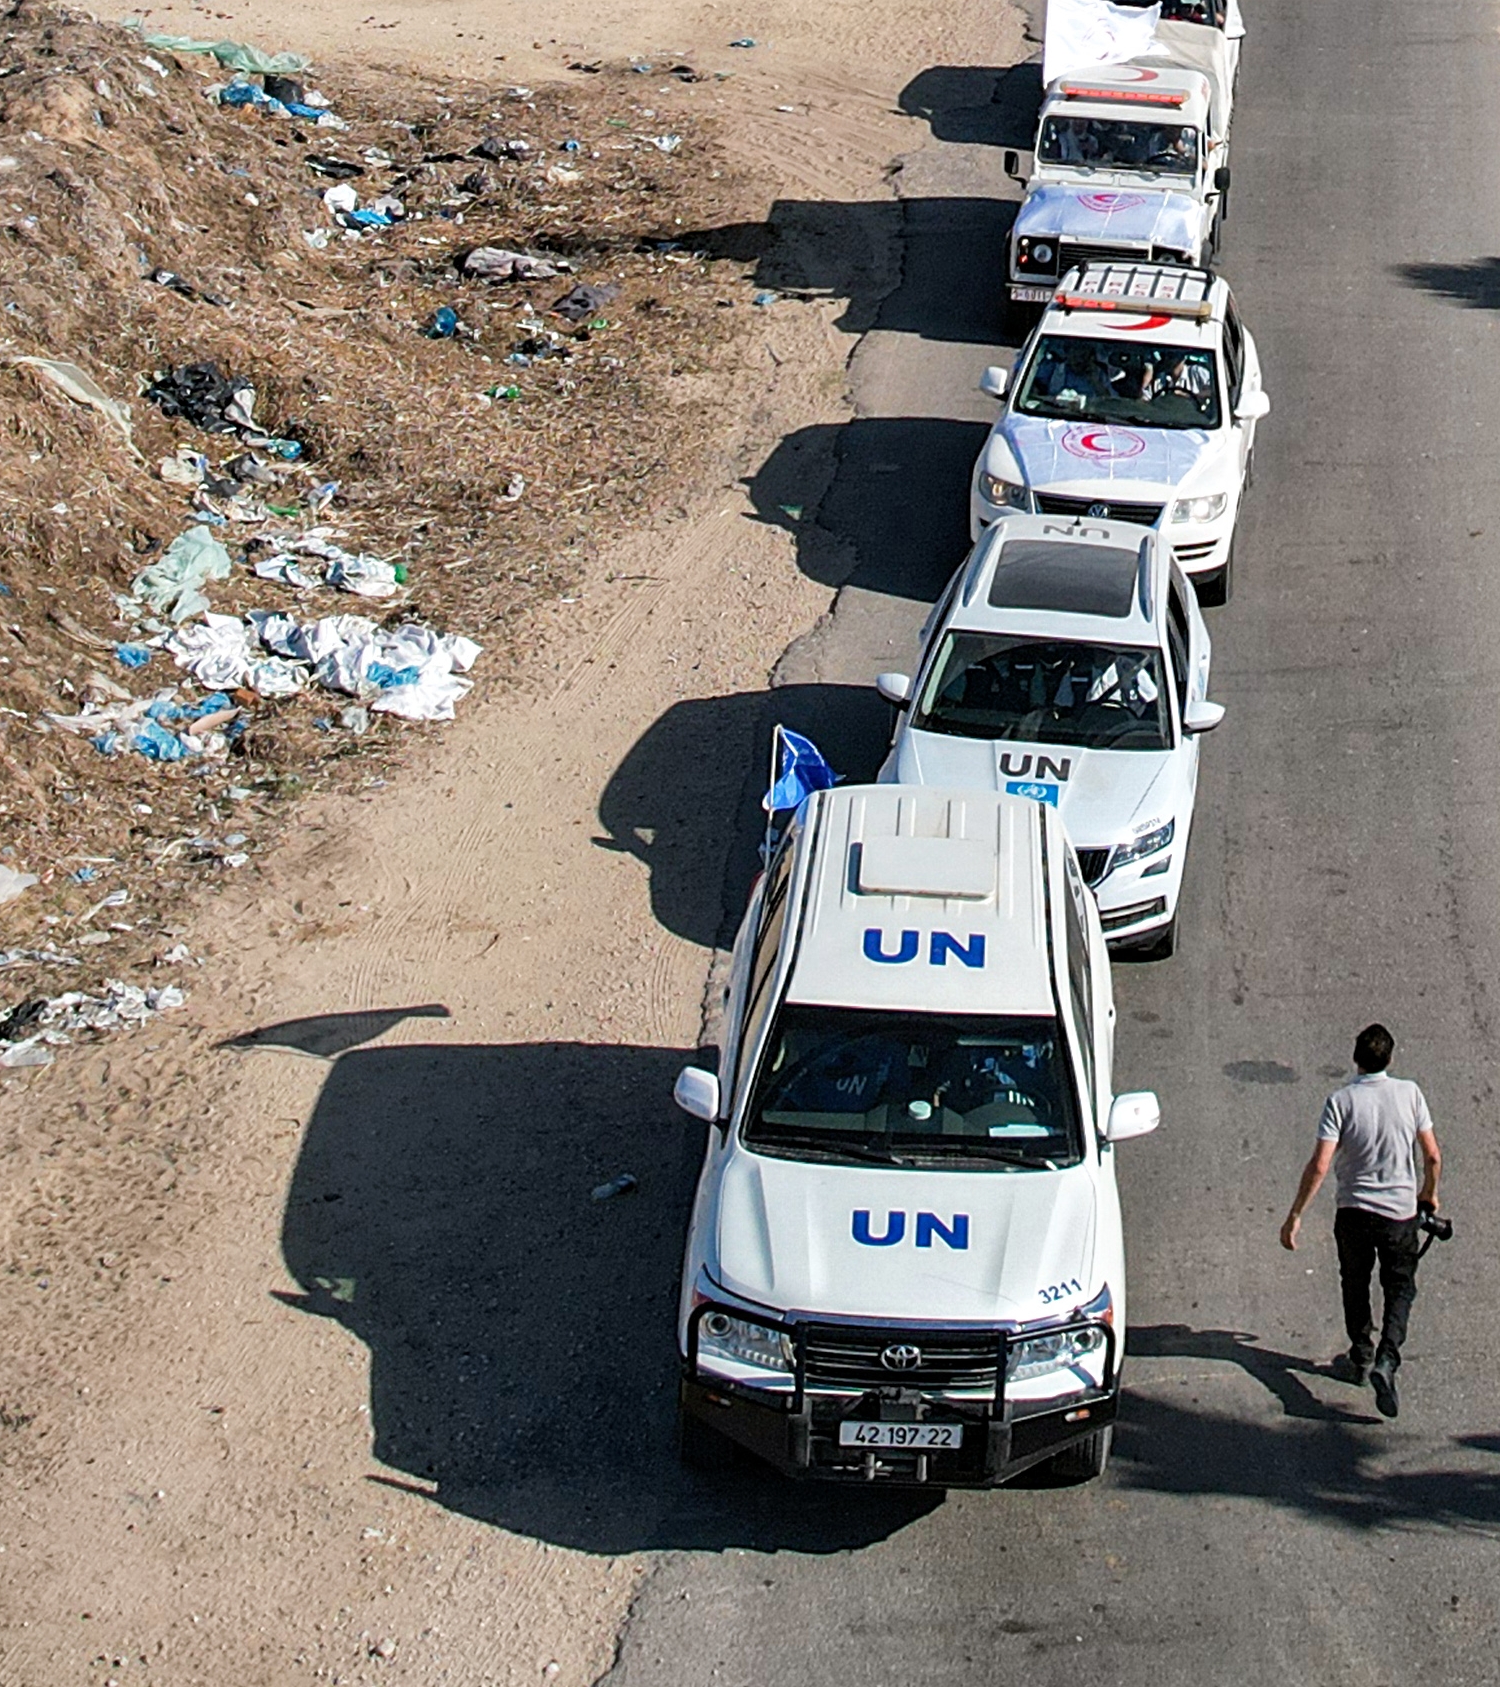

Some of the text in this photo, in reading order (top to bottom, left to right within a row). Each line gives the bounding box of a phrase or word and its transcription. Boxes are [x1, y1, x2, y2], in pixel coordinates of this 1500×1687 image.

[1043, 525, 1110, 539] UN
[999, 753, 1071, 782] UN
[861, 927, 986, 969] UN
[835, 1073, 868, 1096] UN
[851, 1209, 969, 1251] UN
[1038, 1278, 1083, 1304] 3211
